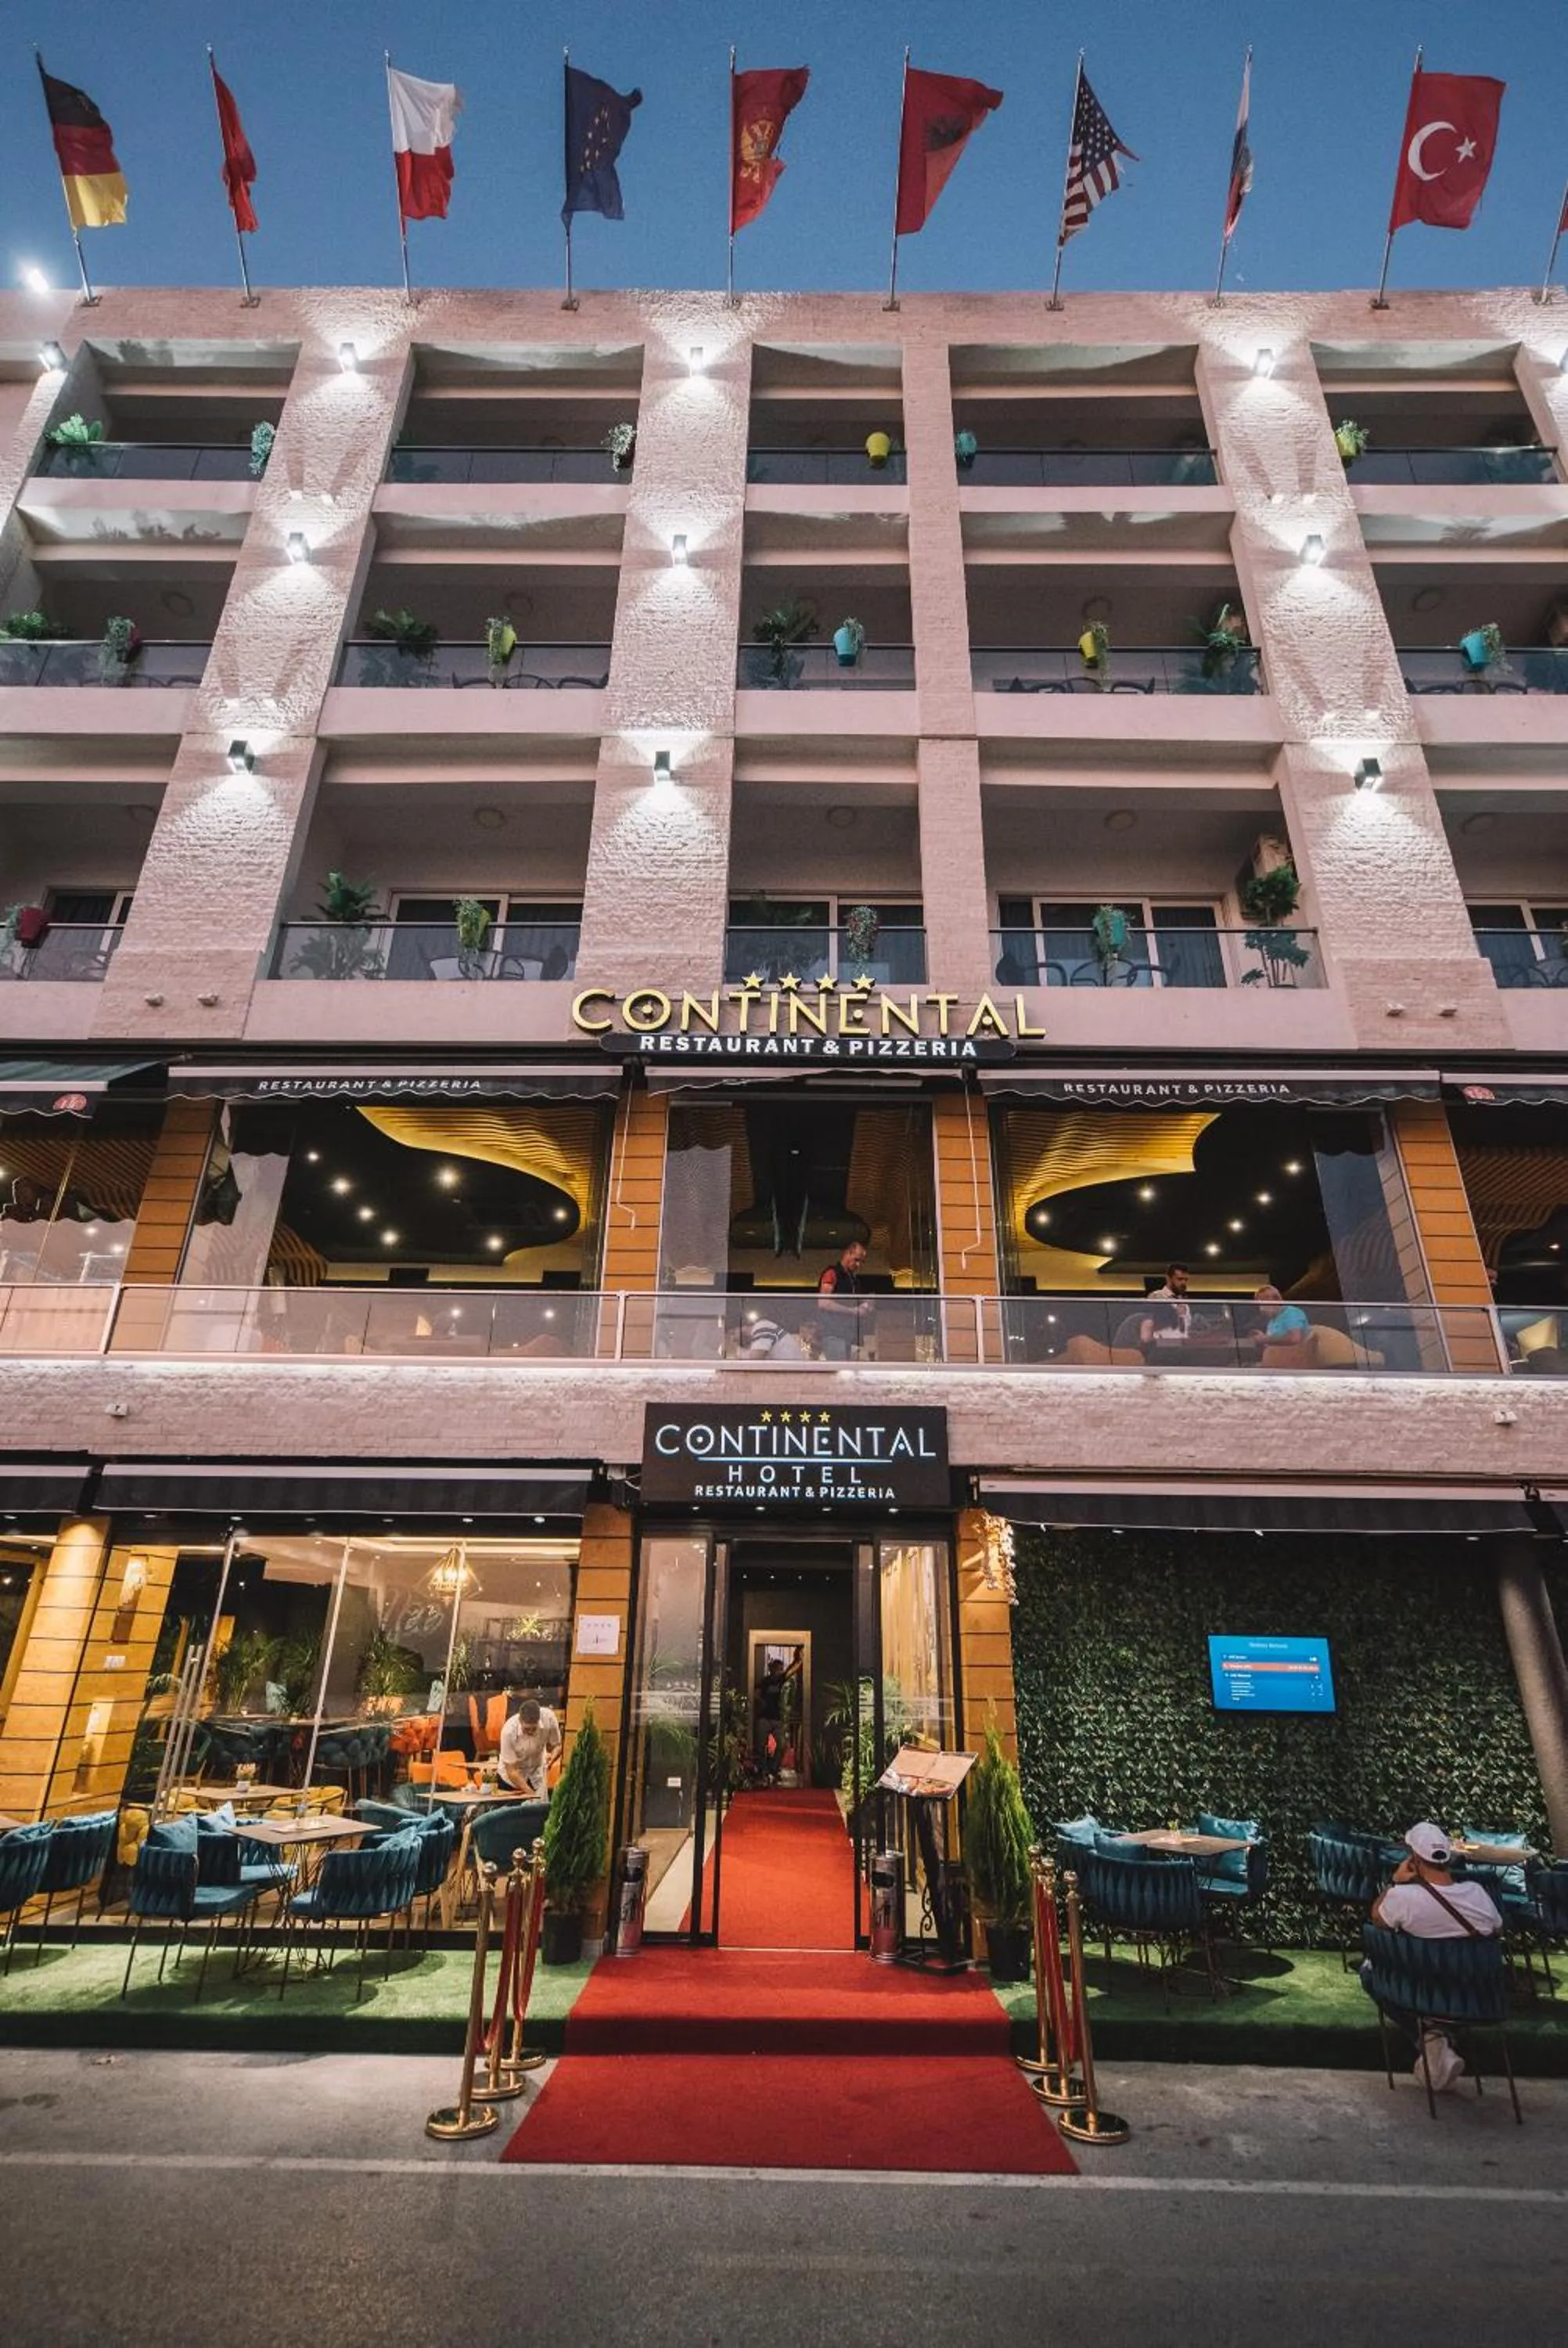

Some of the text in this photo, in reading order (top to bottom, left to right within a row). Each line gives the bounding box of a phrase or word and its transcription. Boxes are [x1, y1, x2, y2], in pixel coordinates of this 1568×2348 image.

[571, 989, 1045, 1039] CONTINENTAL
[639, 1035, 977, 1057] RESTAURANT & PIZZERIA
[257, 1080, 376, 1090] RESTAURANT
[397, 1080, 481, 1089] PIZZERIA
[1063, 1083, 1290, 1095] RESTAURANT & PIZZERIA
[655, 1424, 937, 1457] CONTINENTAL
[728, 1465, 861, 1483] HOTEL
[695, 1486, 896, 1499] RESTAURANT & PIZZERIA
